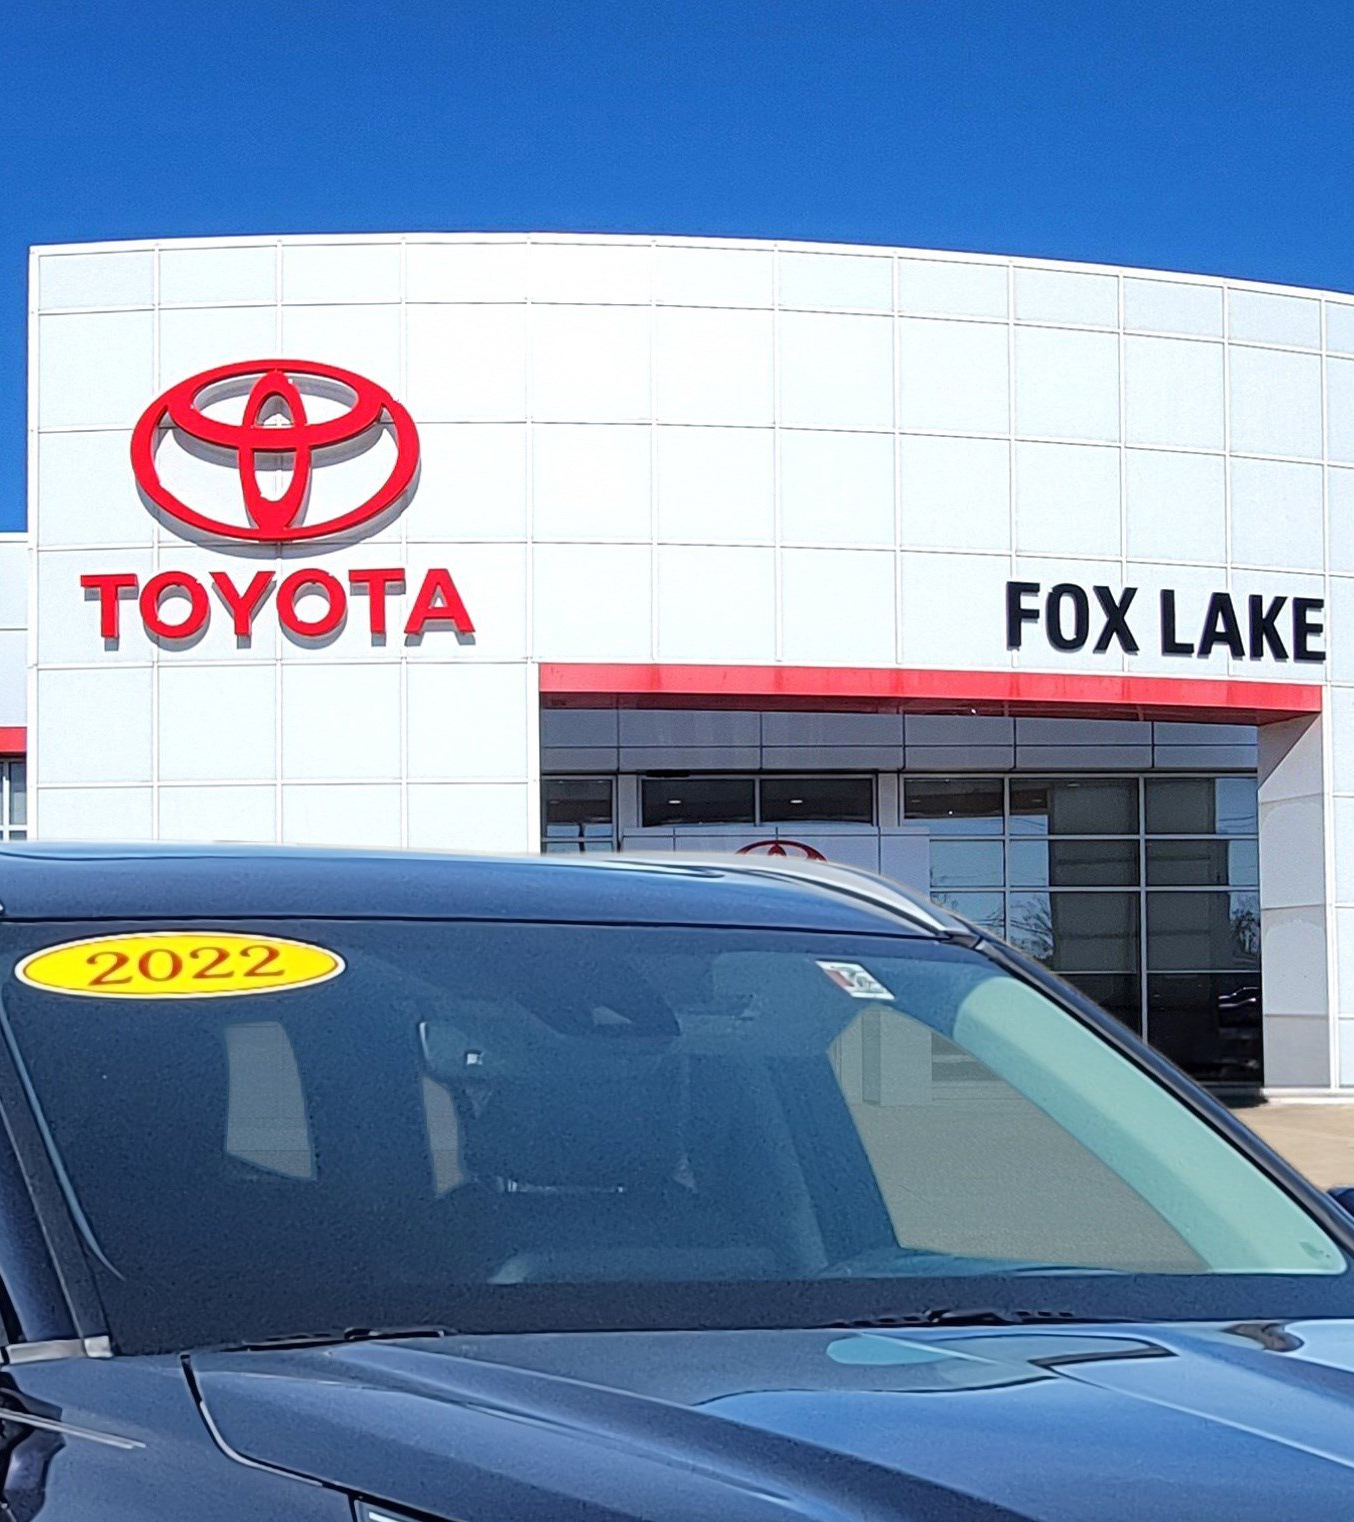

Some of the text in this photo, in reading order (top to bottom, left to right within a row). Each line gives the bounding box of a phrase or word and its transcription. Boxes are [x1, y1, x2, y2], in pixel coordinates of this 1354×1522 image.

[80, 567, 477, 642] TOYOTA
[1006, 581, 1327, 661] FOX LAKE
[85, 944, 286, 987] 2022
